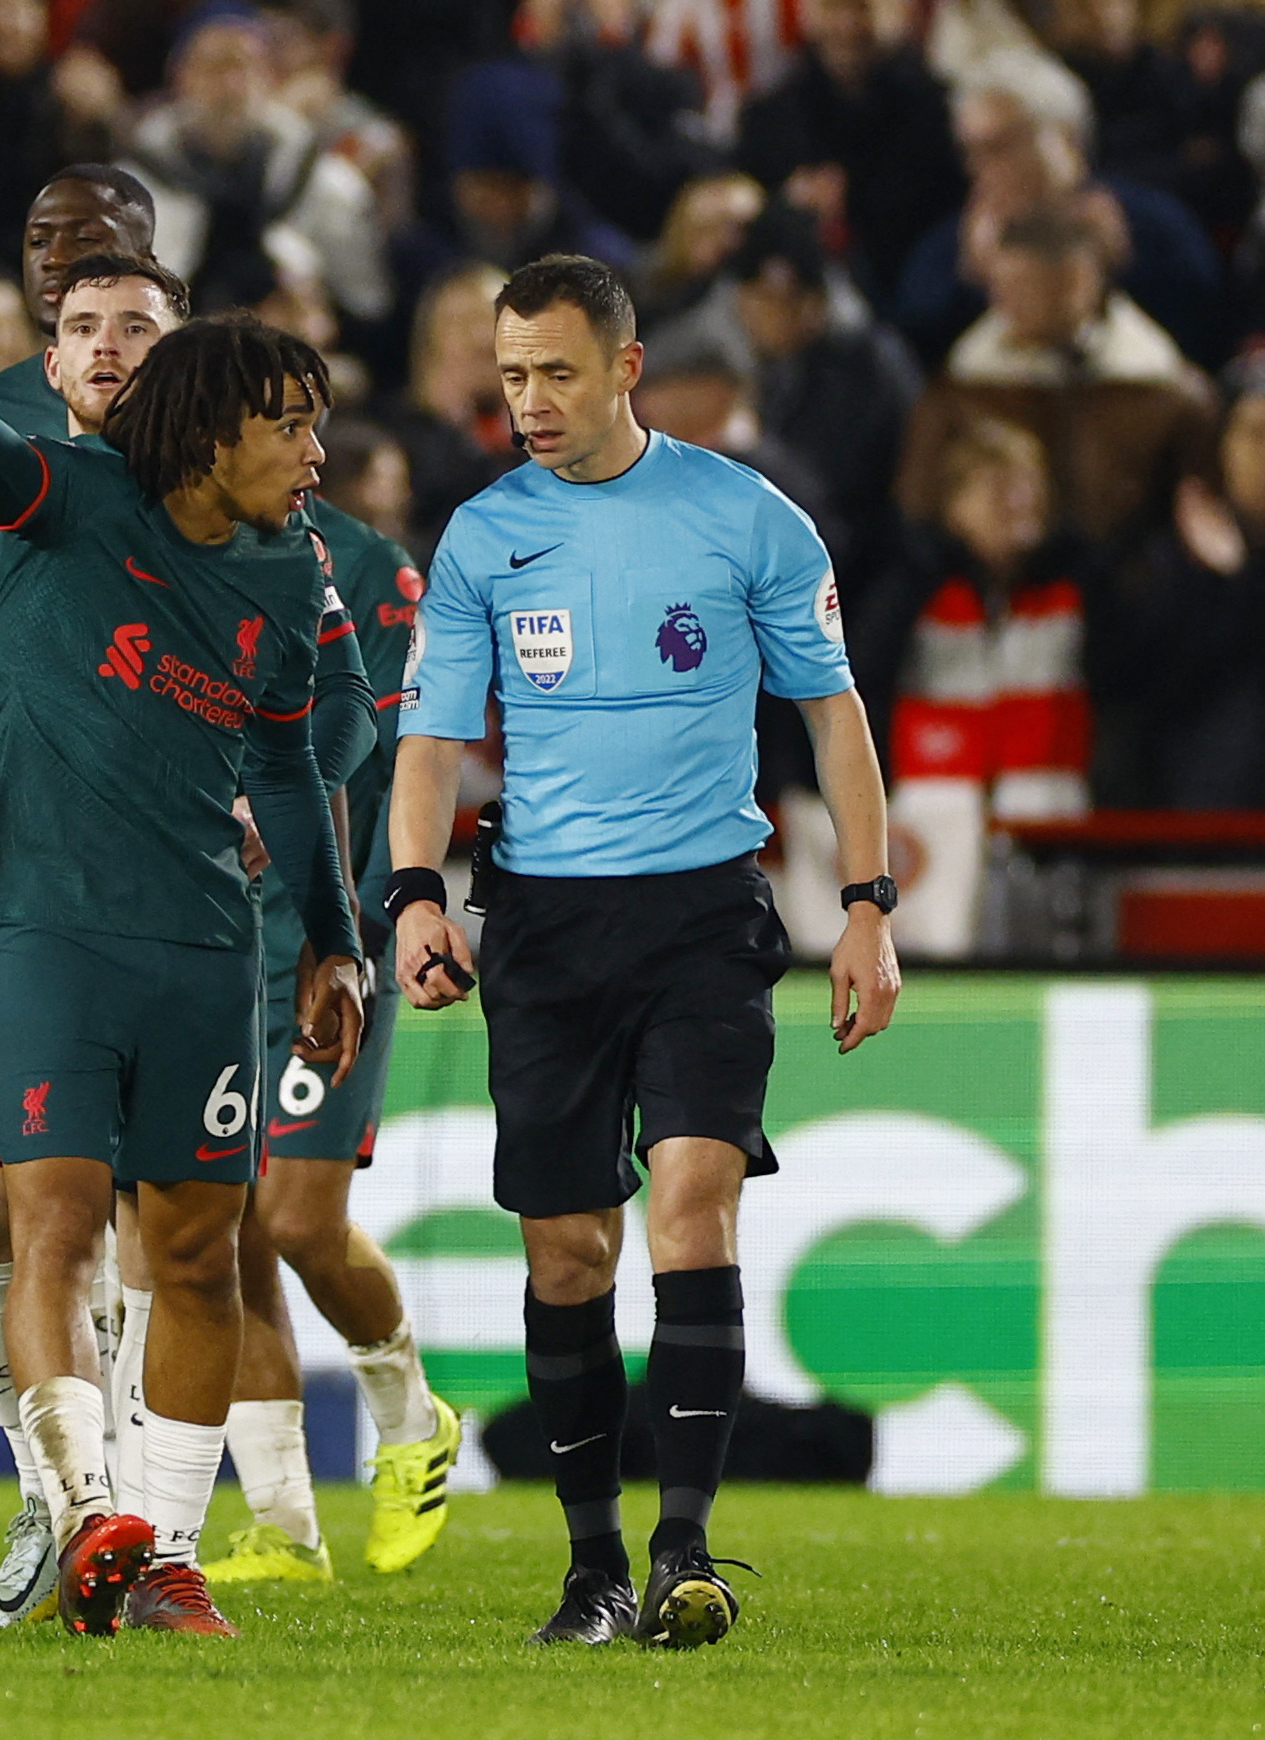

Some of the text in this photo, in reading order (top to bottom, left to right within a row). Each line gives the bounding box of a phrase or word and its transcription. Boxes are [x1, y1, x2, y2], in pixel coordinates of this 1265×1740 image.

[515, 615, 564, 635] FIFA
[519, 647, 567, 659] REFEREE
[535, 675, 556, 684] 2022
[279, 1054, 325, 1116] 6
